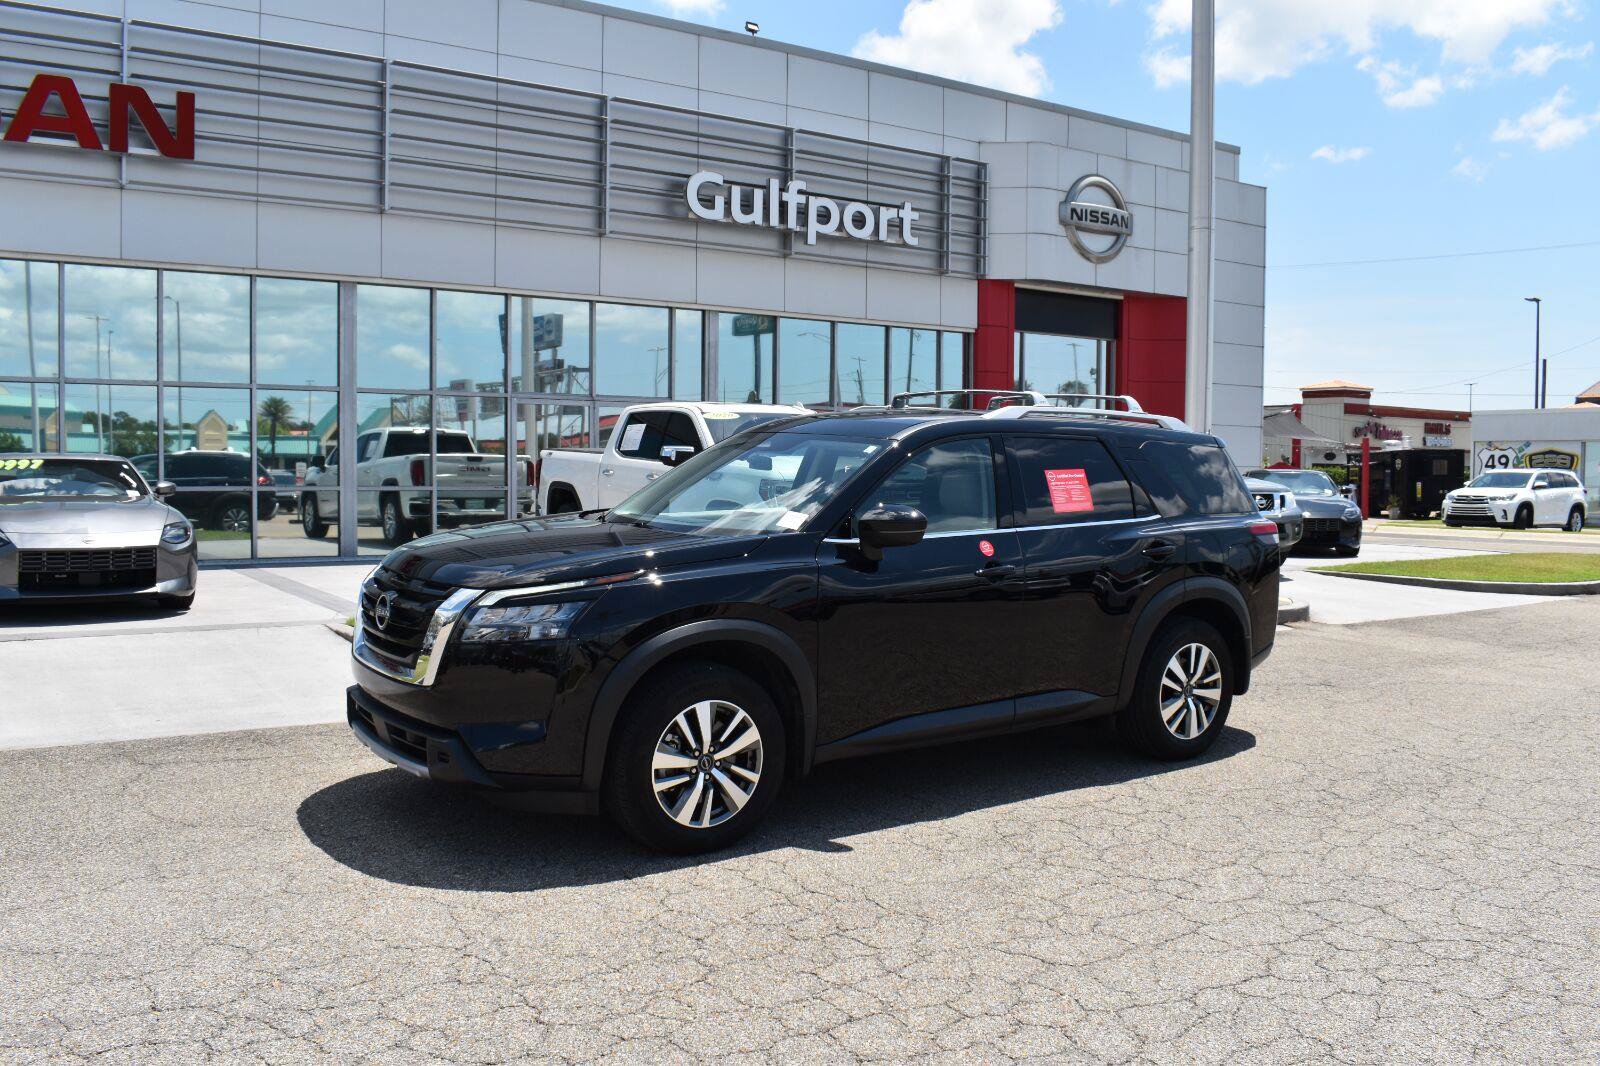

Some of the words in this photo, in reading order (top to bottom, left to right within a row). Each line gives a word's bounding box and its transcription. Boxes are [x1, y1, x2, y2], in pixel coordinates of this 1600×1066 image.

[686, 170, 919, 246] Gulfport
[1070, 207, 1129, 229] NISSAN
[1484, 454, 1510, 469] 49
